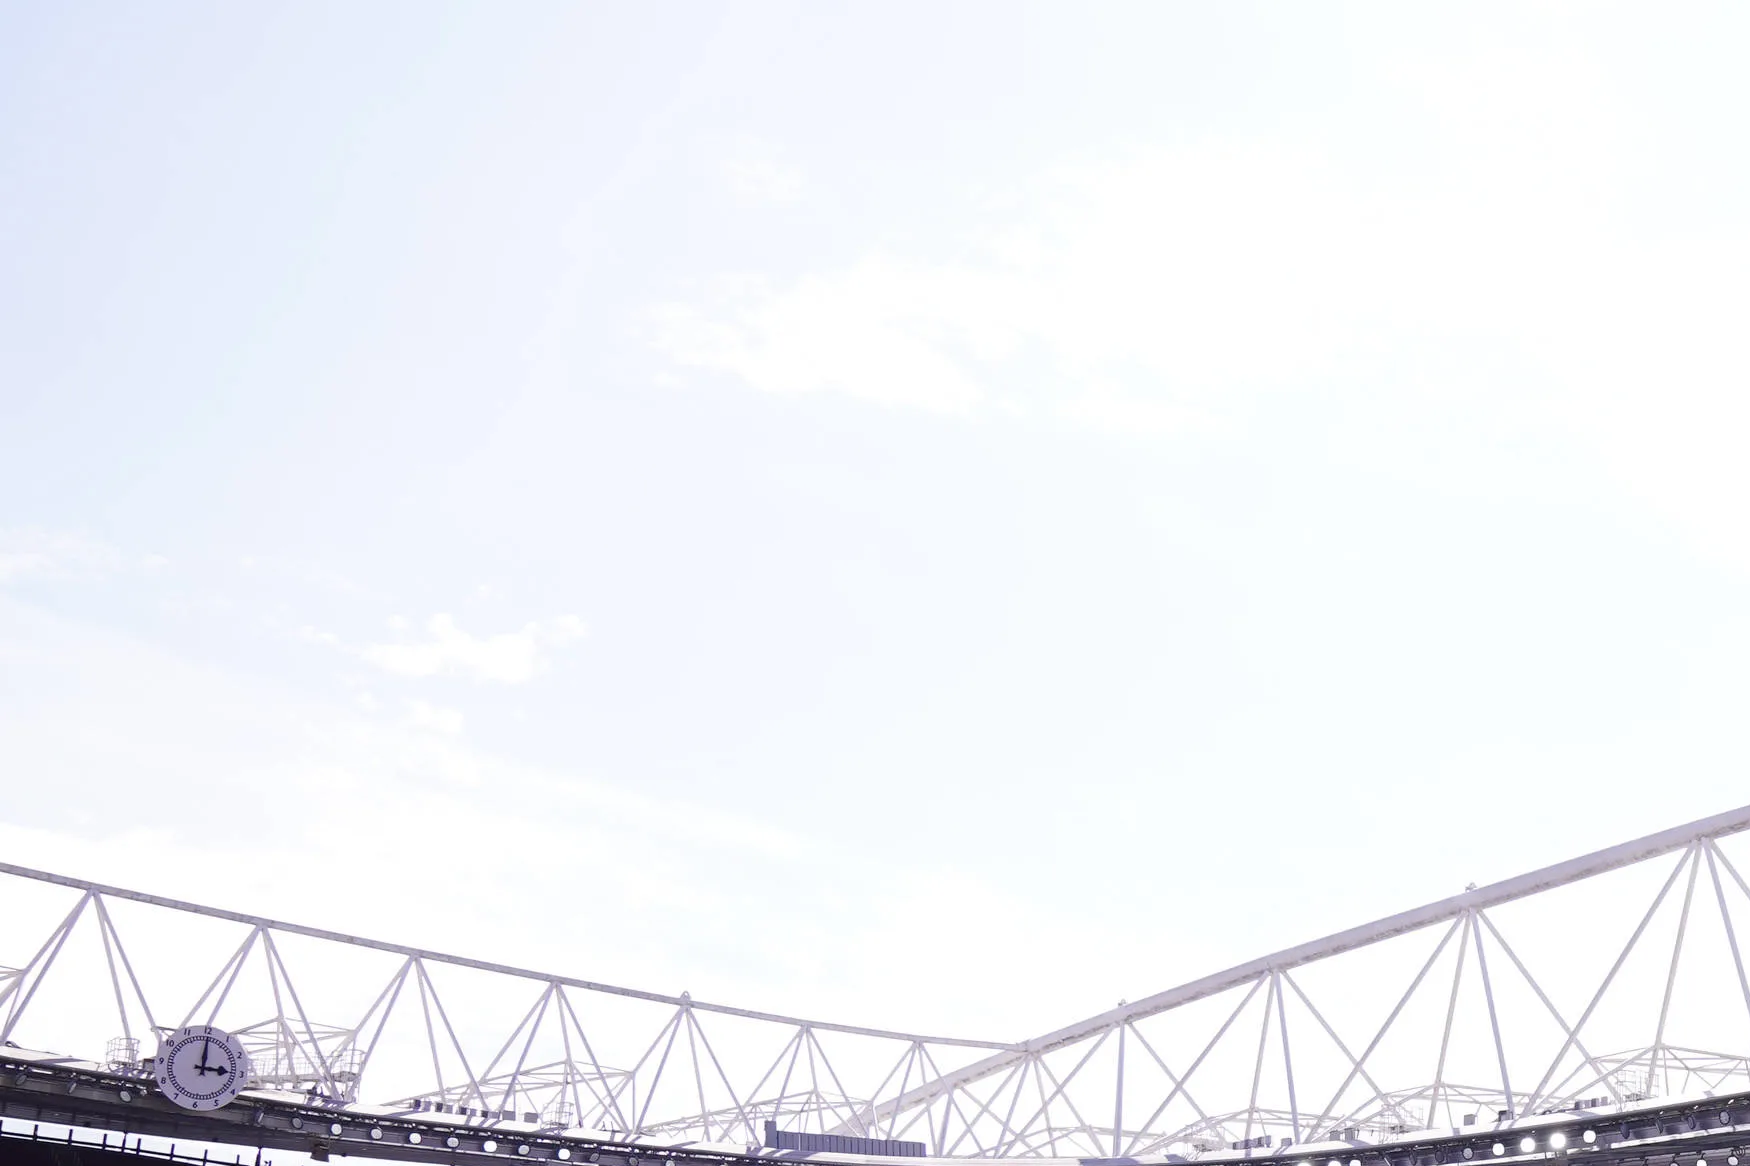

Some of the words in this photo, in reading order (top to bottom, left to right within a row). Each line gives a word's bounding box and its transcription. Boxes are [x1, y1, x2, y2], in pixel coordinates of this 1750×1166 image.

[183, 1028, 191, 1037] 11
[204, 1027, 212, 1035] 12
[166, 1039, 175, 1047] 10
[237, 1051, 243, 1059] 2
[158, 1057, 164, 1065] 9
[239, 1070, 244, 1078] 3
[174, 1092, 179, 1100] 7
[230, 1088, 236, 1096] 4
[192, 1101, 198, 1109] 6
[214, 1099, 219, 1107] 5
